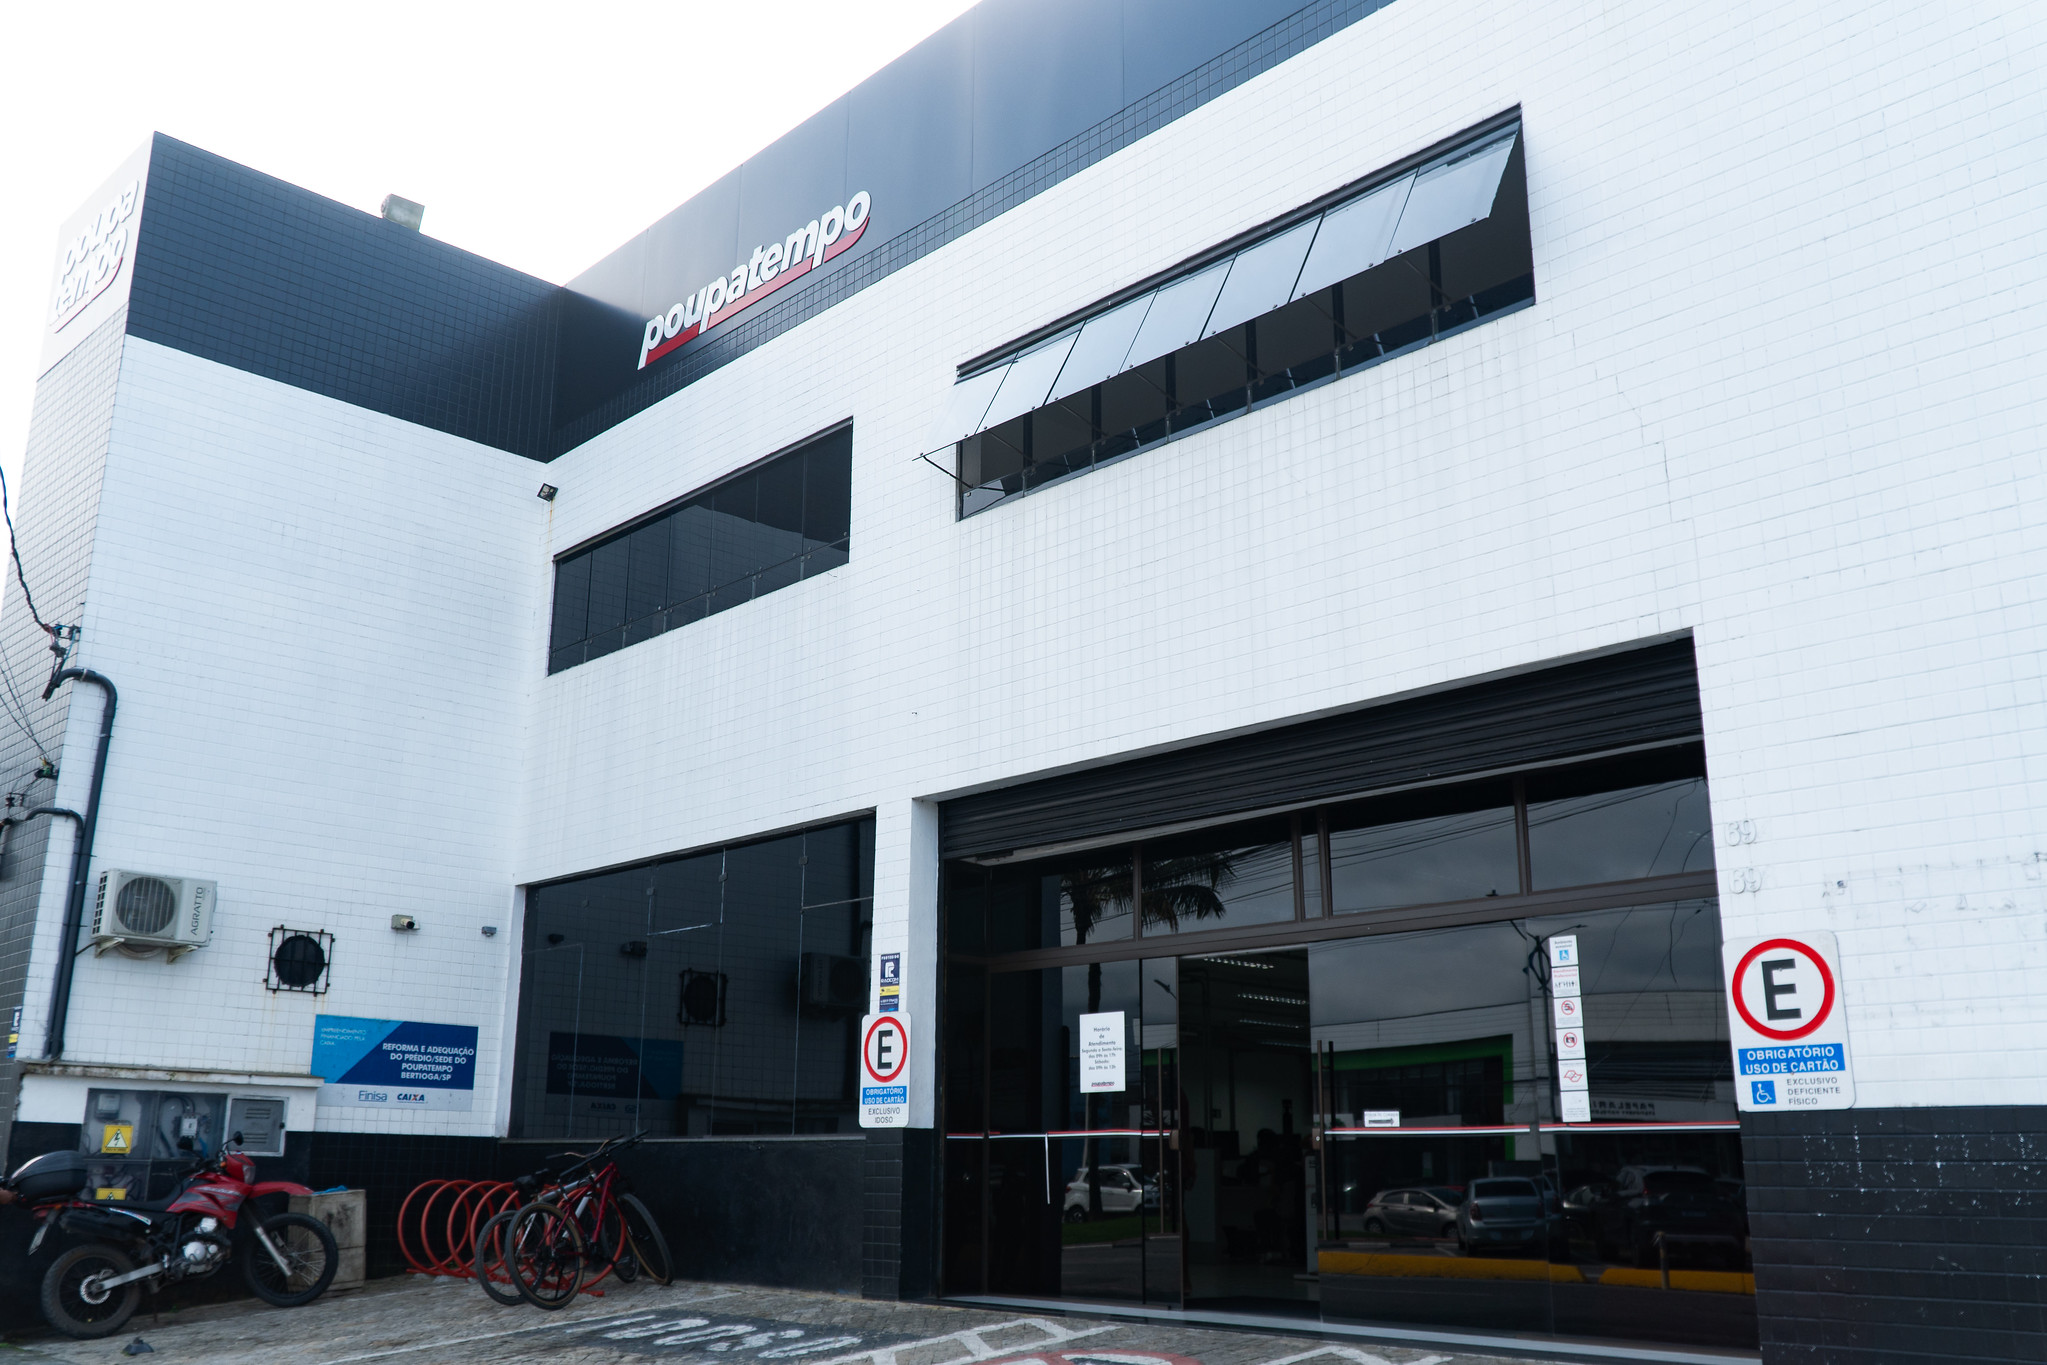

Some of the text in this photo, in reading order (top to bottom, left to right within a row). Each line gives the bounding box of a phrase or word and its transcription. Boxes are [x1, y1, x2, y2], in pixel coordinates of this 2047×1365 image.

[637, 190, 872, 371] poupatempo
[190, 887, 204, 936] AGRATTO
[1761, 958, 1802, 1020] E
[382, 1043, 475, 1057] REFORMA E ADEQUAÇÃO
[877, 1029, 893, 1069] E
[1747, 1045, 1835, 1060] OBRIGATÓRIO
[390, 1052, 467, 1065] DO PRÉDIO/SEDE DO
[401, 1062, 453, 1073] POUPATEMPO
[1745, 1058, 1839, 1075] USO DE CARTÃO
[400, 1071, 452, 1081] BERTIOGA/SP
[1786, 1076, 1838, 1086] EXCLUSIVO
[358, 1089, 388, 1102] Finisa
[865, 1086, 904, 1097] OBRIGATÓRIO
[1787, 1086, 1841, 1096] DEFICIENTE
[396, 1092, 425, 1102] CAIXA
[864, 1094, 905, 1105] USO DE CARTÃO
[1788, 1095, 1819, 1106] FÍSICO
[868, 1106, 901, 1116] EXCLUSIVO
[874, 1116, 894, 1124] IDOSO
